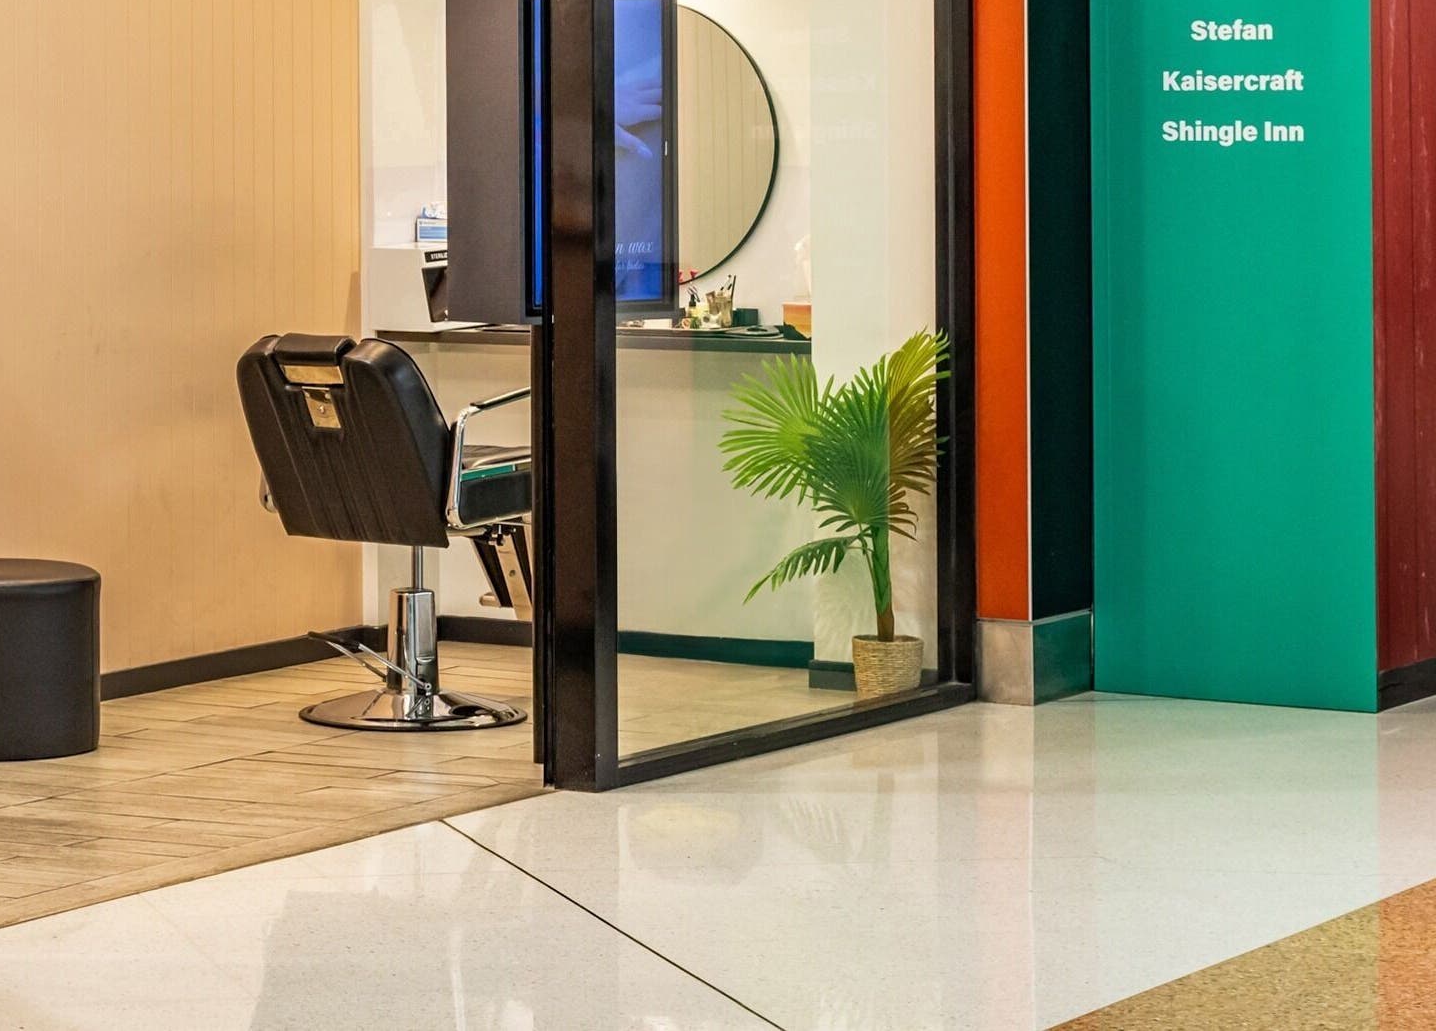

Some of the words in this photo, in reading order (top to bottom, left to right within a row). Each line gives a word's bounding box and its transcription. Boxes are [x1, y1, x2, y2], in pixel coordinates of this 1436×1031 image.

[1190, 19, 1273, 41] Stefan
[1163, 70, 1303, 91] Kaisercraft
[1162, 121, 1257, 146] Shingle
[1264, 121, 1304, 141] Inn
